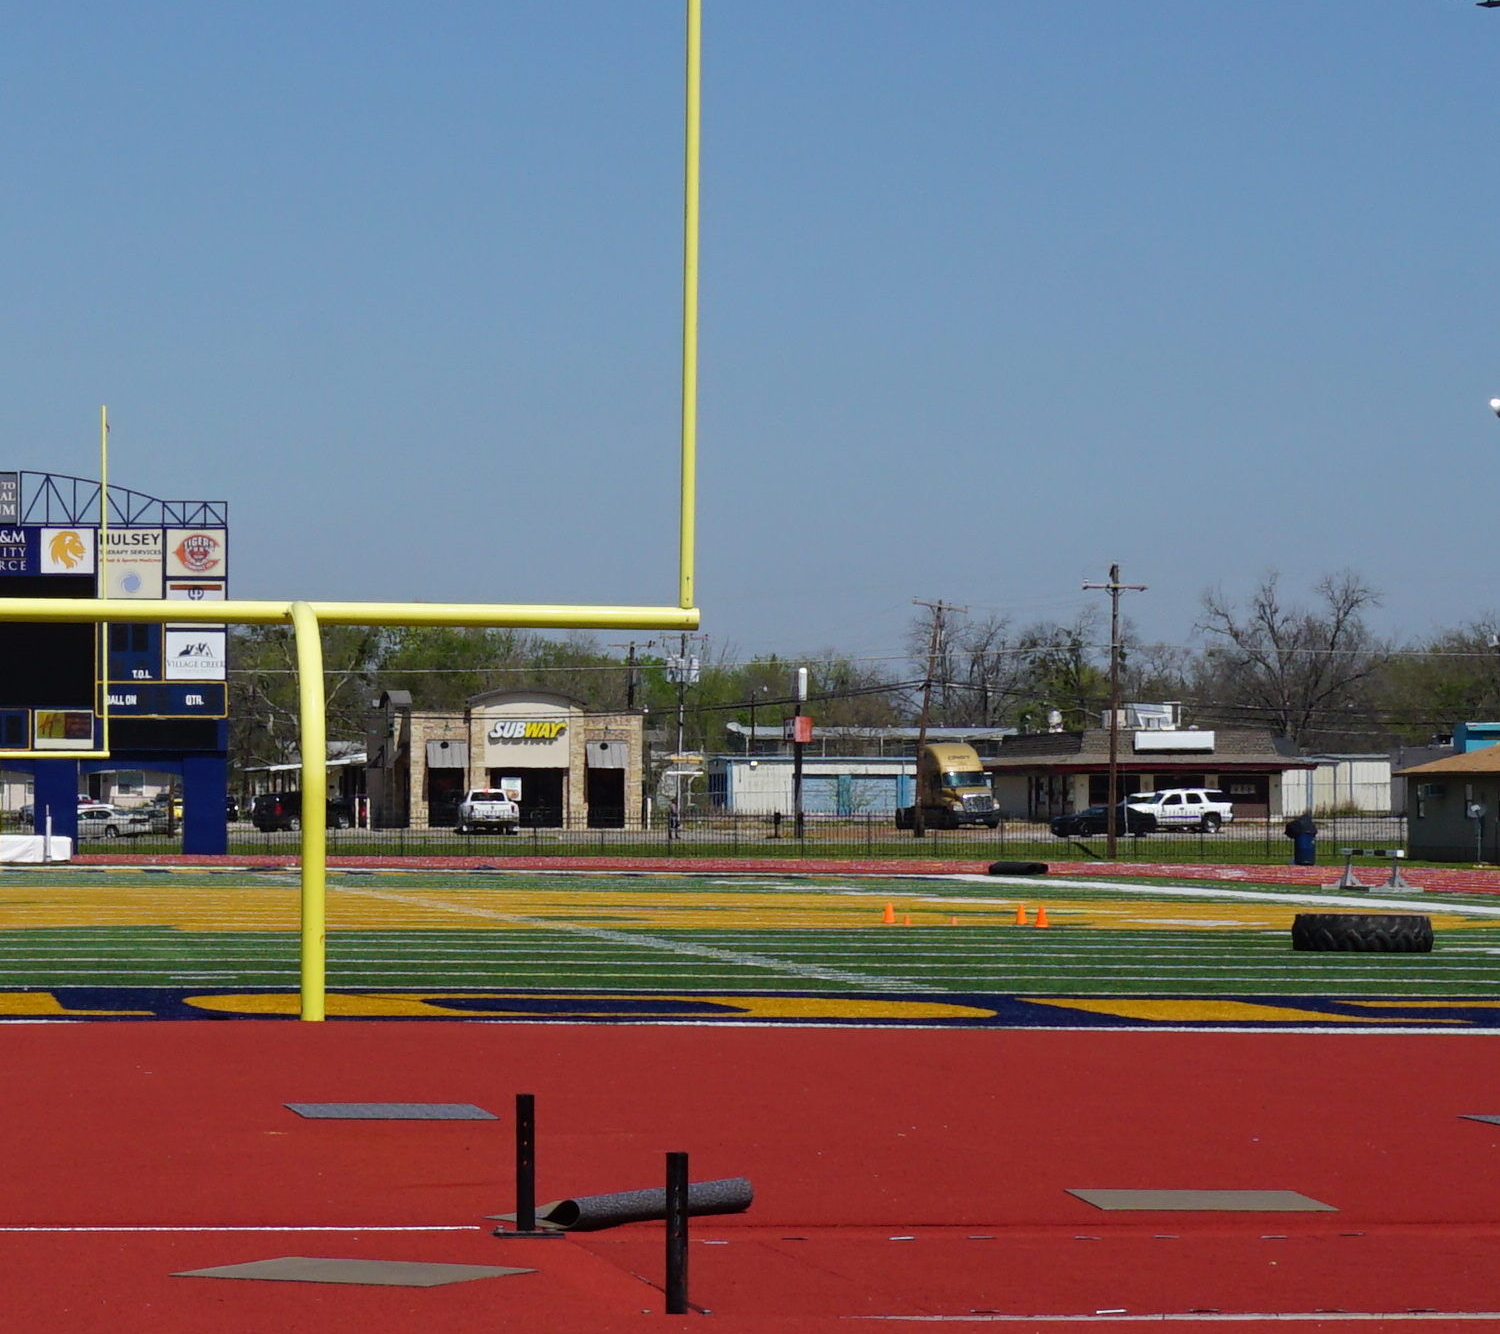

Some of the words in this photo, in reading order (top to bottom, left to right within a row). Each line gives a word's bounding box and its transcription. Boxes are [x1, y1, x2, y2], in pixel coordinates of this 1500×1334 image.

[1, 481, 16, 490] TO
[100, 533, 161, 545] HULSEY
[183, 536, 216, 552] TIGERS
[167, 660, 198, 668] VILLAGE
[132, 670, 153, 678] T.O.L.
[106, 695, 124, 705] BALL
[125, 695, 137, 705] ON
[489, 721, 567, 738] SUBWAY
